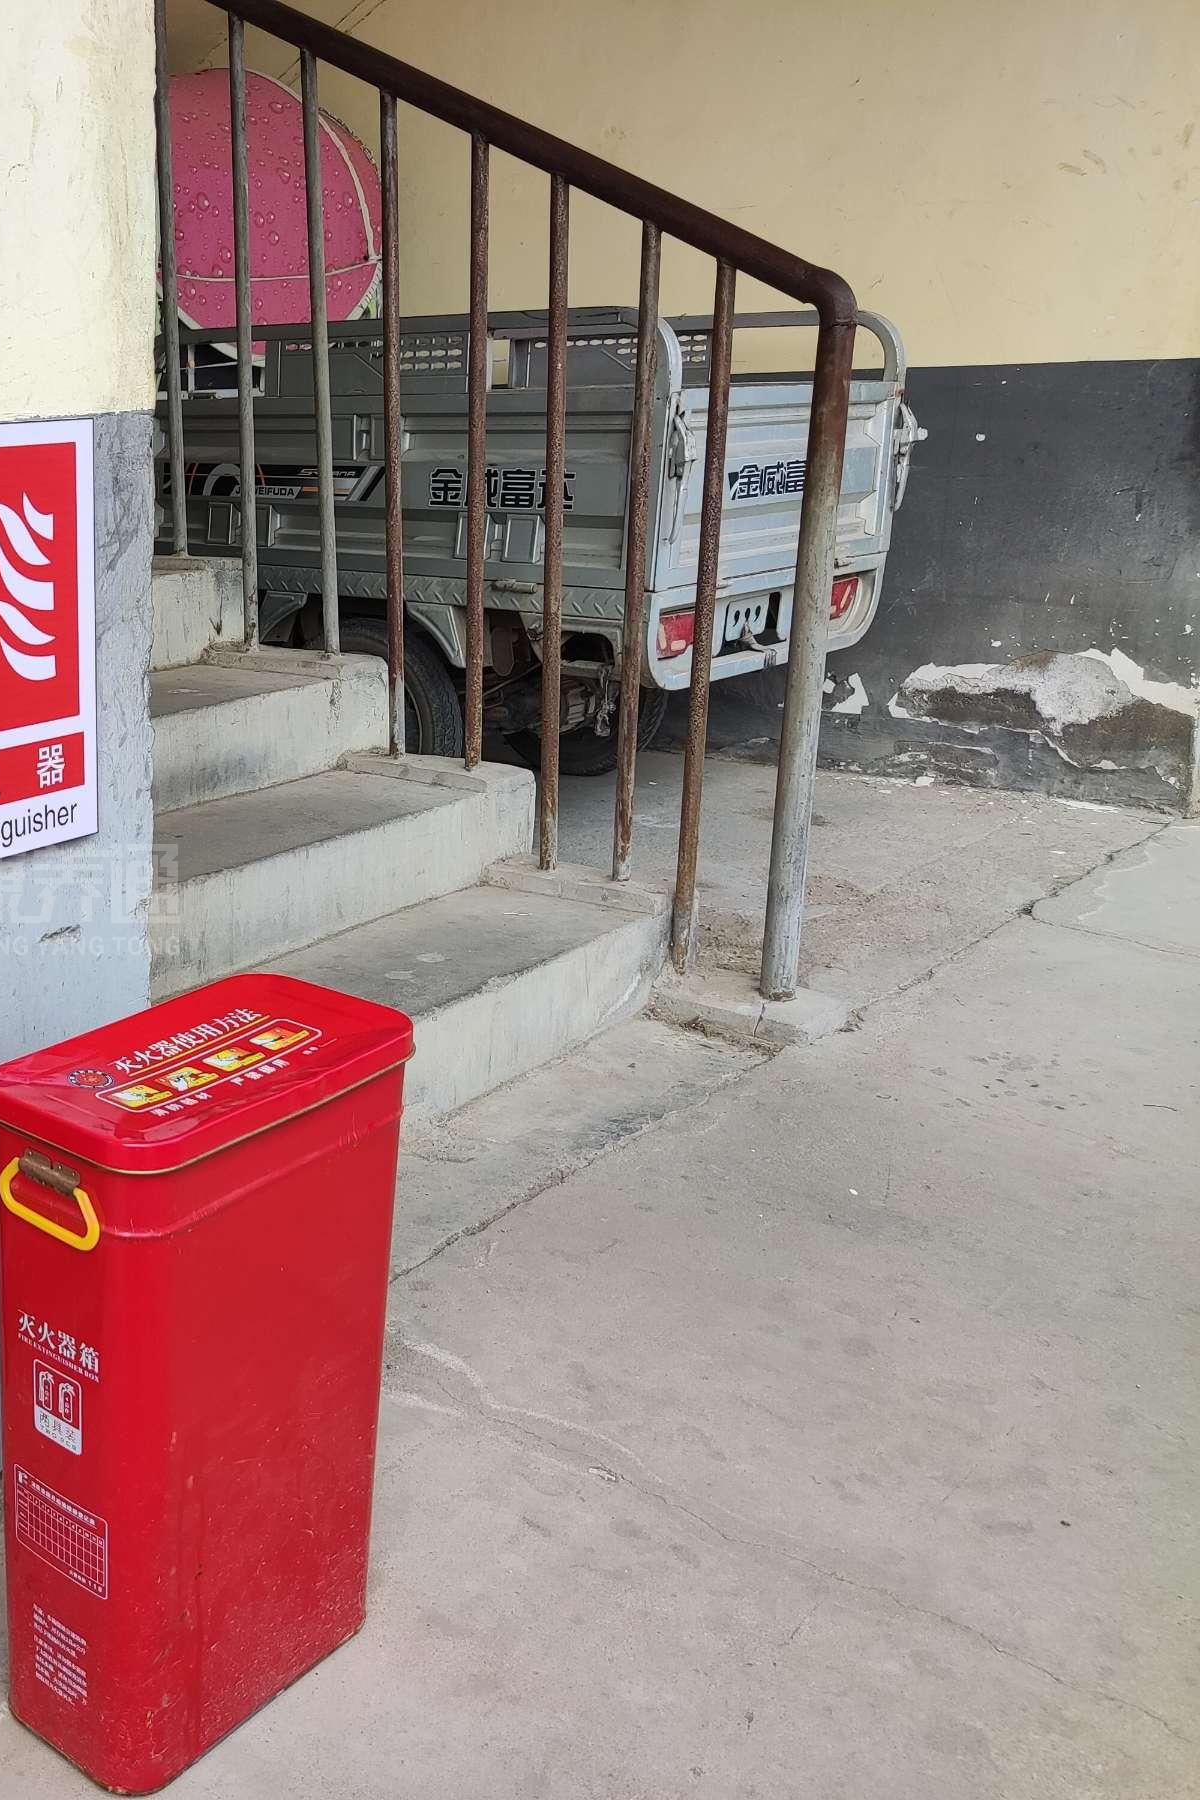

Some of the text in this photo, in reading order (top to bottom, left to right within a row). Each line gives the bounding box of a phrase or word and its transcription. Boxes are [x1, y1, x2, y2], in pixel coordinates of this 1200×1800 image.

[107, 1008, 262, 1074] 灭火器使用方法
[17, 1309, 99, 1374] 灭火器箱
